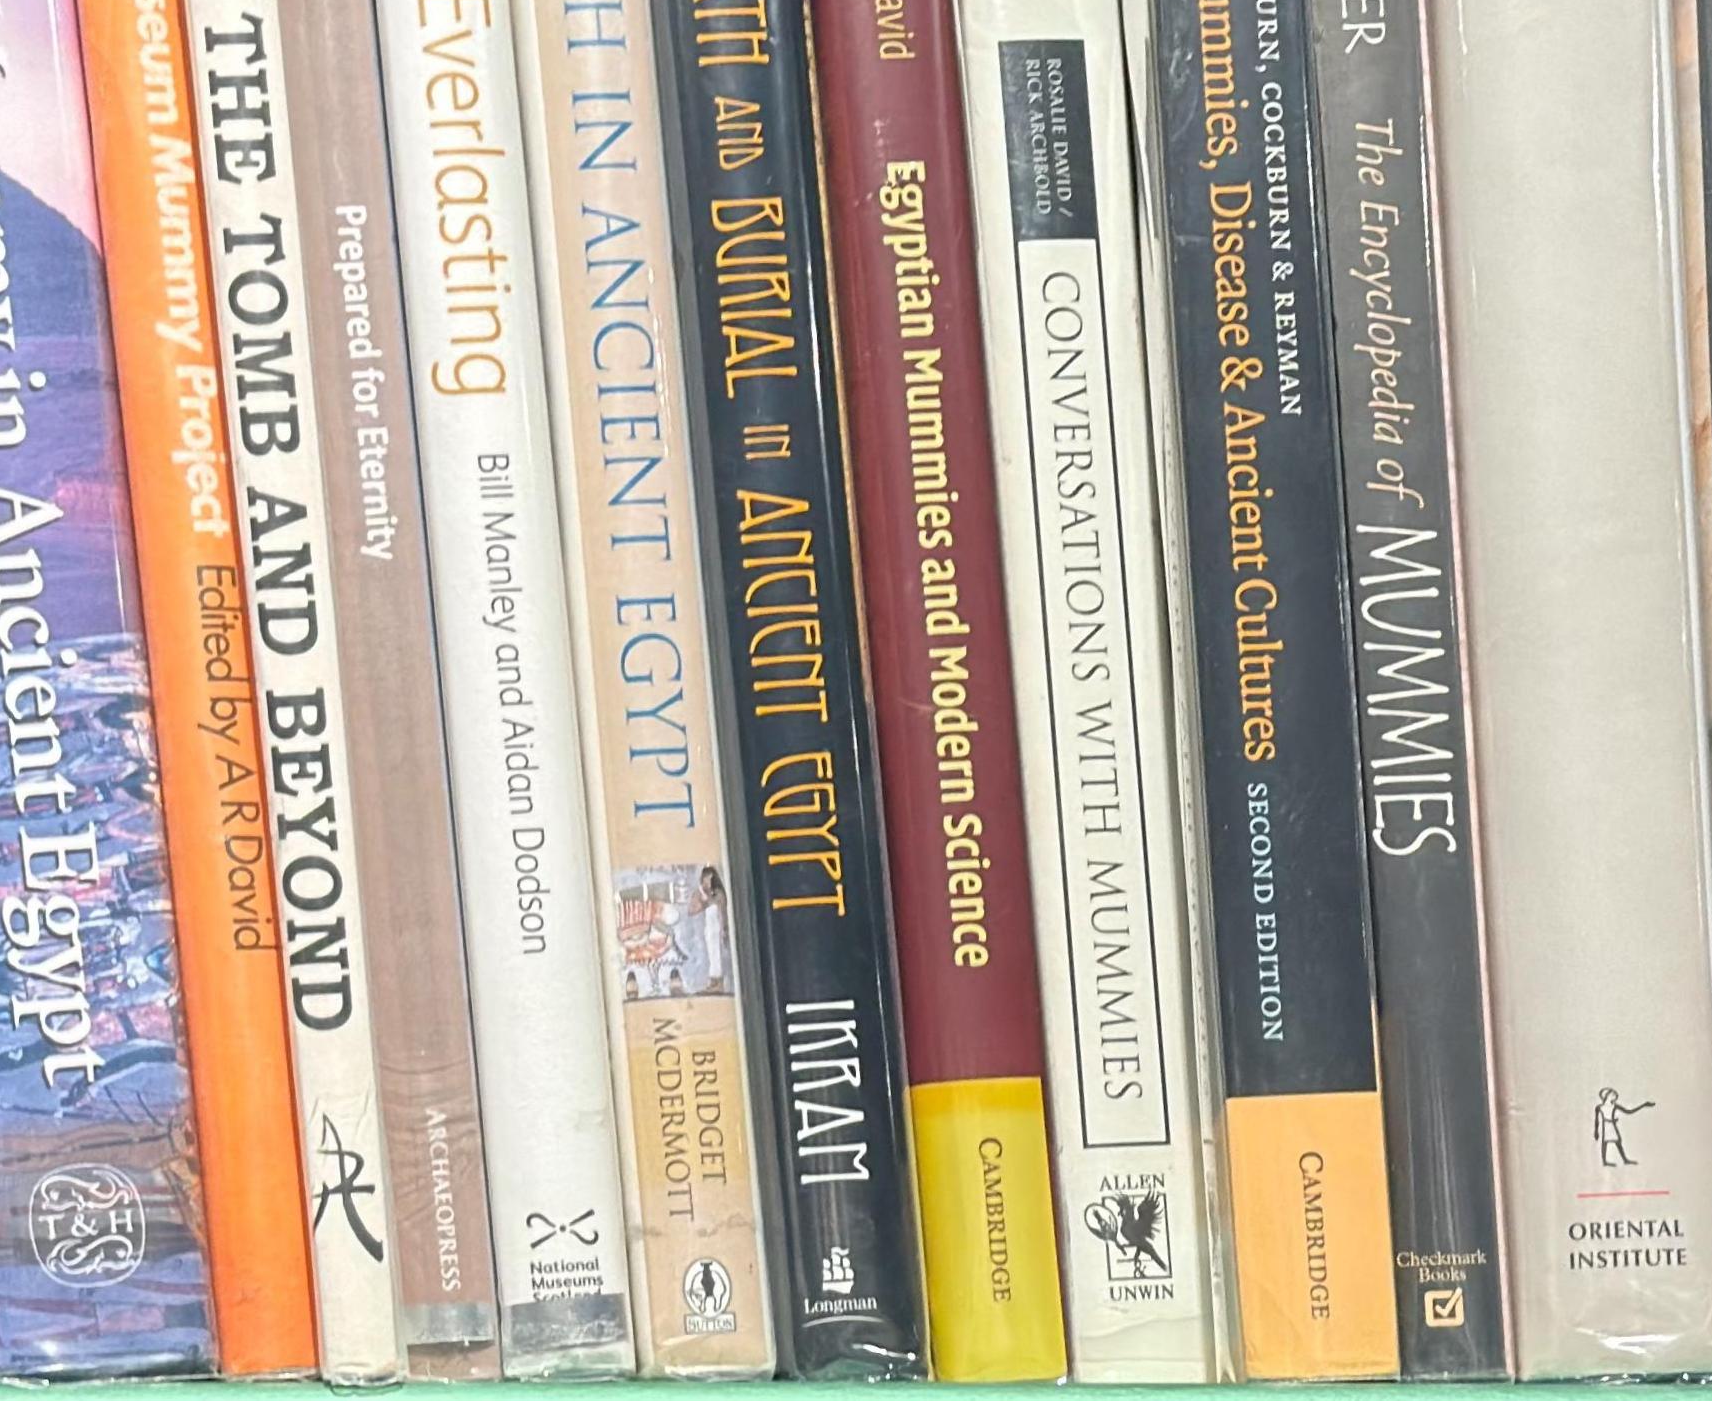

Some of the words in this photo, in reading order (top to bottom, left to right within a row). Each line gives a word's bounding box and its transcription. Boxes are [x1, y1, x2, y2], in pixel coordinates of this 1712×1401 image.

[203, 11, 277, 185] THE
[1024, 57, 1043, 102] RICK
[1046, 57, 1068, 135] ROSALIE
[1027, 105, 1053, 217] ARCHBOLD
[1052, 136, 1073, 202] DAVID
[1263, 80, 1295, 250] COCKBURN
[1354, 117, 1404, 187] The
[149, 134, 203, 354] Mummy
[334, 204, 384, 360] Prepared
[1208, 181, 1256, 348] Disease
[1272, 259, 1294, 282] &
[222, 212, 301, 457] TOMB
[1219, 356, 1264, 392] &
[1274, 290, 1302, 416] REYMAN
[1349, 196, 1416, 447] Encyclopedia
[171, 363, 229, 538] Project
[350, 367, 385, 419] for
[355, 424, 399, 563] Eternity
[477, 452, 515, 503] Bill
[1040, 270, 1113, 684] CONVERSATIONS
[1222, 401, 1274, 575] Ancient
[1365, 458, 1425, 509] of
[246, 485, 319, 657] AND
[481, 510, 524, 636] Manley
[494, 642, 534, 708] and
[1233, 577, 1285, 763] Cultures
[1355, 523, 1457, 857] MUMMIES
[501, 715, 541, 816] Aidan
[1073, 703, 1123, 838] WITH
[265, 686, 354, 1033] BEYOND
[511, 826, 547, 956] Dodson
[1247, 782, 1275, 905] SECOND
[1085, 858, 1144, 1101] MUMMIES
[1255, 912, 1285, 1042] EDITION
[692, 1049, 728, 1185] BRIDGET
[785, 999, 870, 1185] IKRAM
[420, 1106, 462, 1292] ARCHAEOPRESS
[1099, 1173, 1165, 1191] ALLEN
[1568, 1219, 1685, 1242] ORIENTAL
[530, 1257, 599, 1275] National
[531, 1274, 604, 1290] Museums
[804, 1295, 878, 1316] Longman
[1109, 1284, 1174, 1301] UNWIN
[1396, 1248, 1487, 1268] Checkmark
[1419, 1264, 1467, 1283] Books
[1569, 1247, 1688, 1270] INSTITUTE
